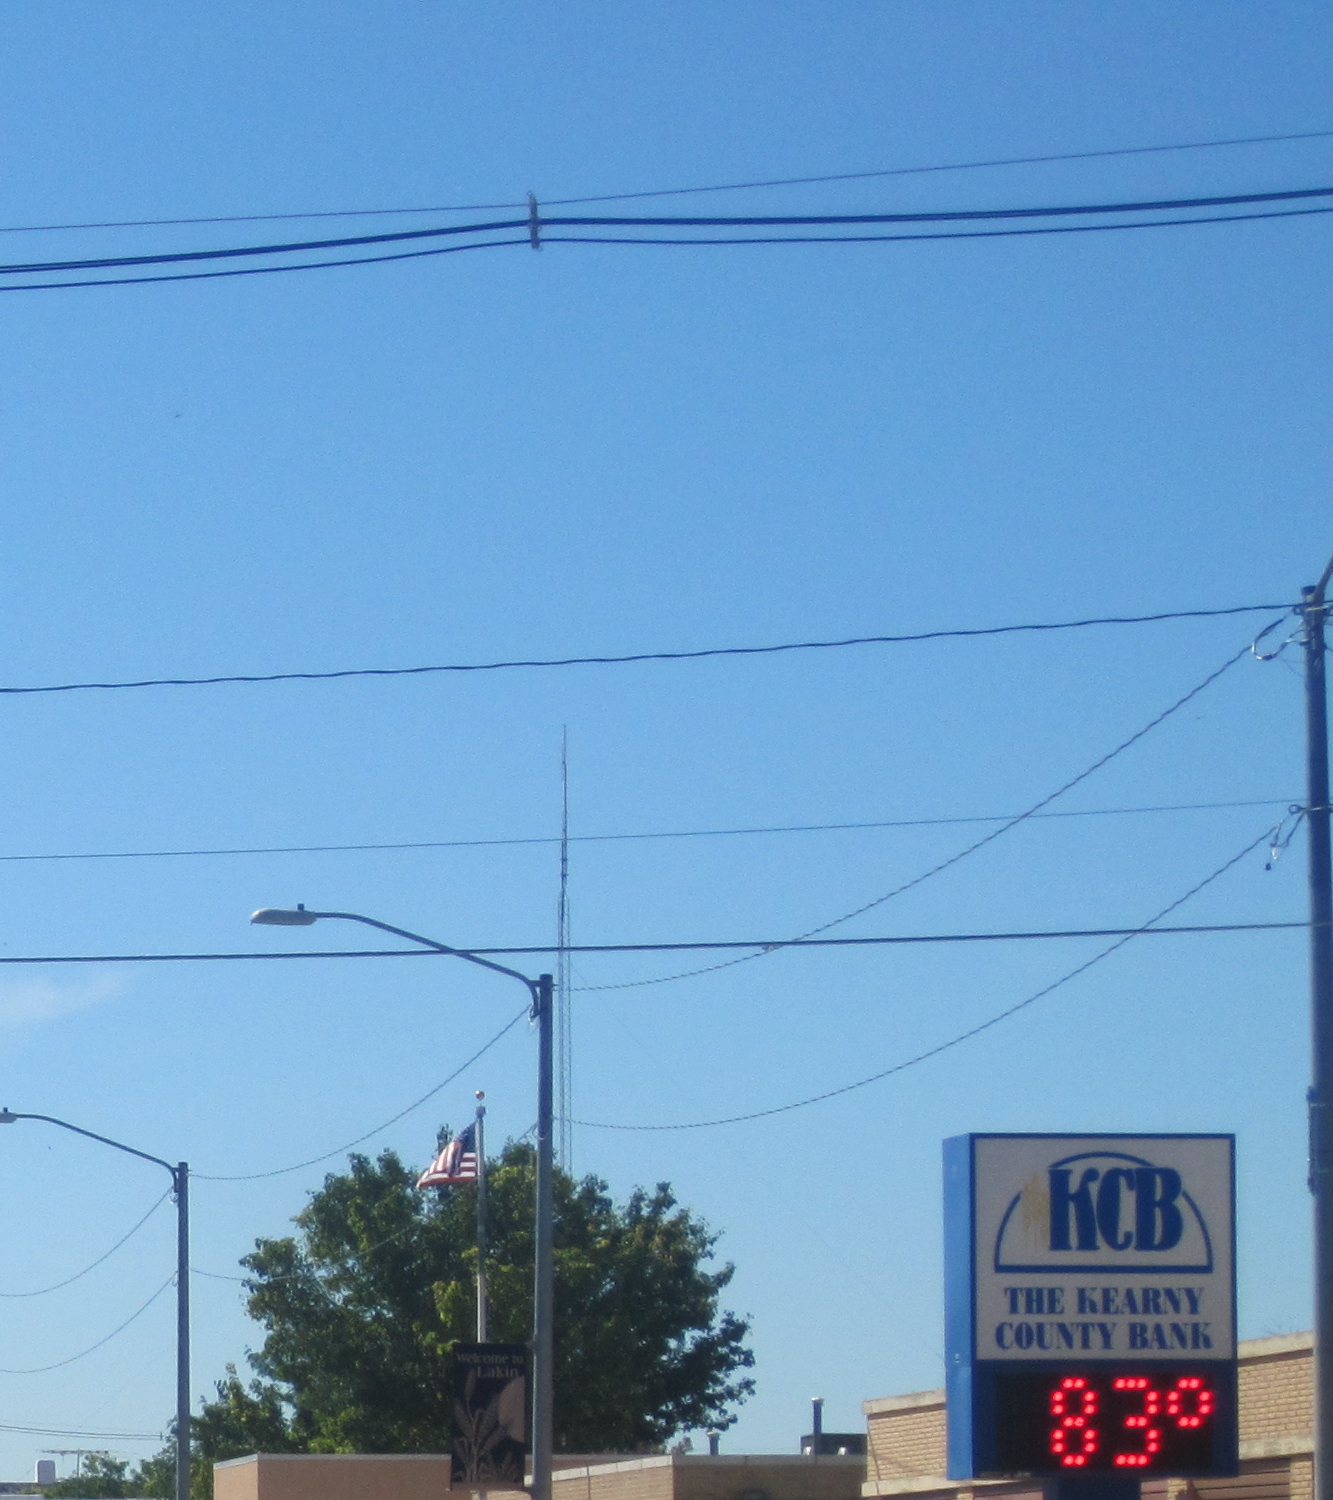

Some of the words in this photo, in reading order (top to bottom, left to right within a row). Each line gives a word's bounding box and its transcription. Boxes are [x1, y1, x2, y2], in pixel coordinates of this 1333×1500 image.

[1048, 1166, 1183, 1252] KCB
[1004, 1287, 1065, 1315] THE
[1077, 1287, 1204, 1315] KEARNY
[994, 1322, 1117, 1350] COUNTY
[1128, 1322, 1214, 1350] BANK
[456, 1353, 508, 1364] Welcome
[477, 1366, 519, 1378] Lakin
